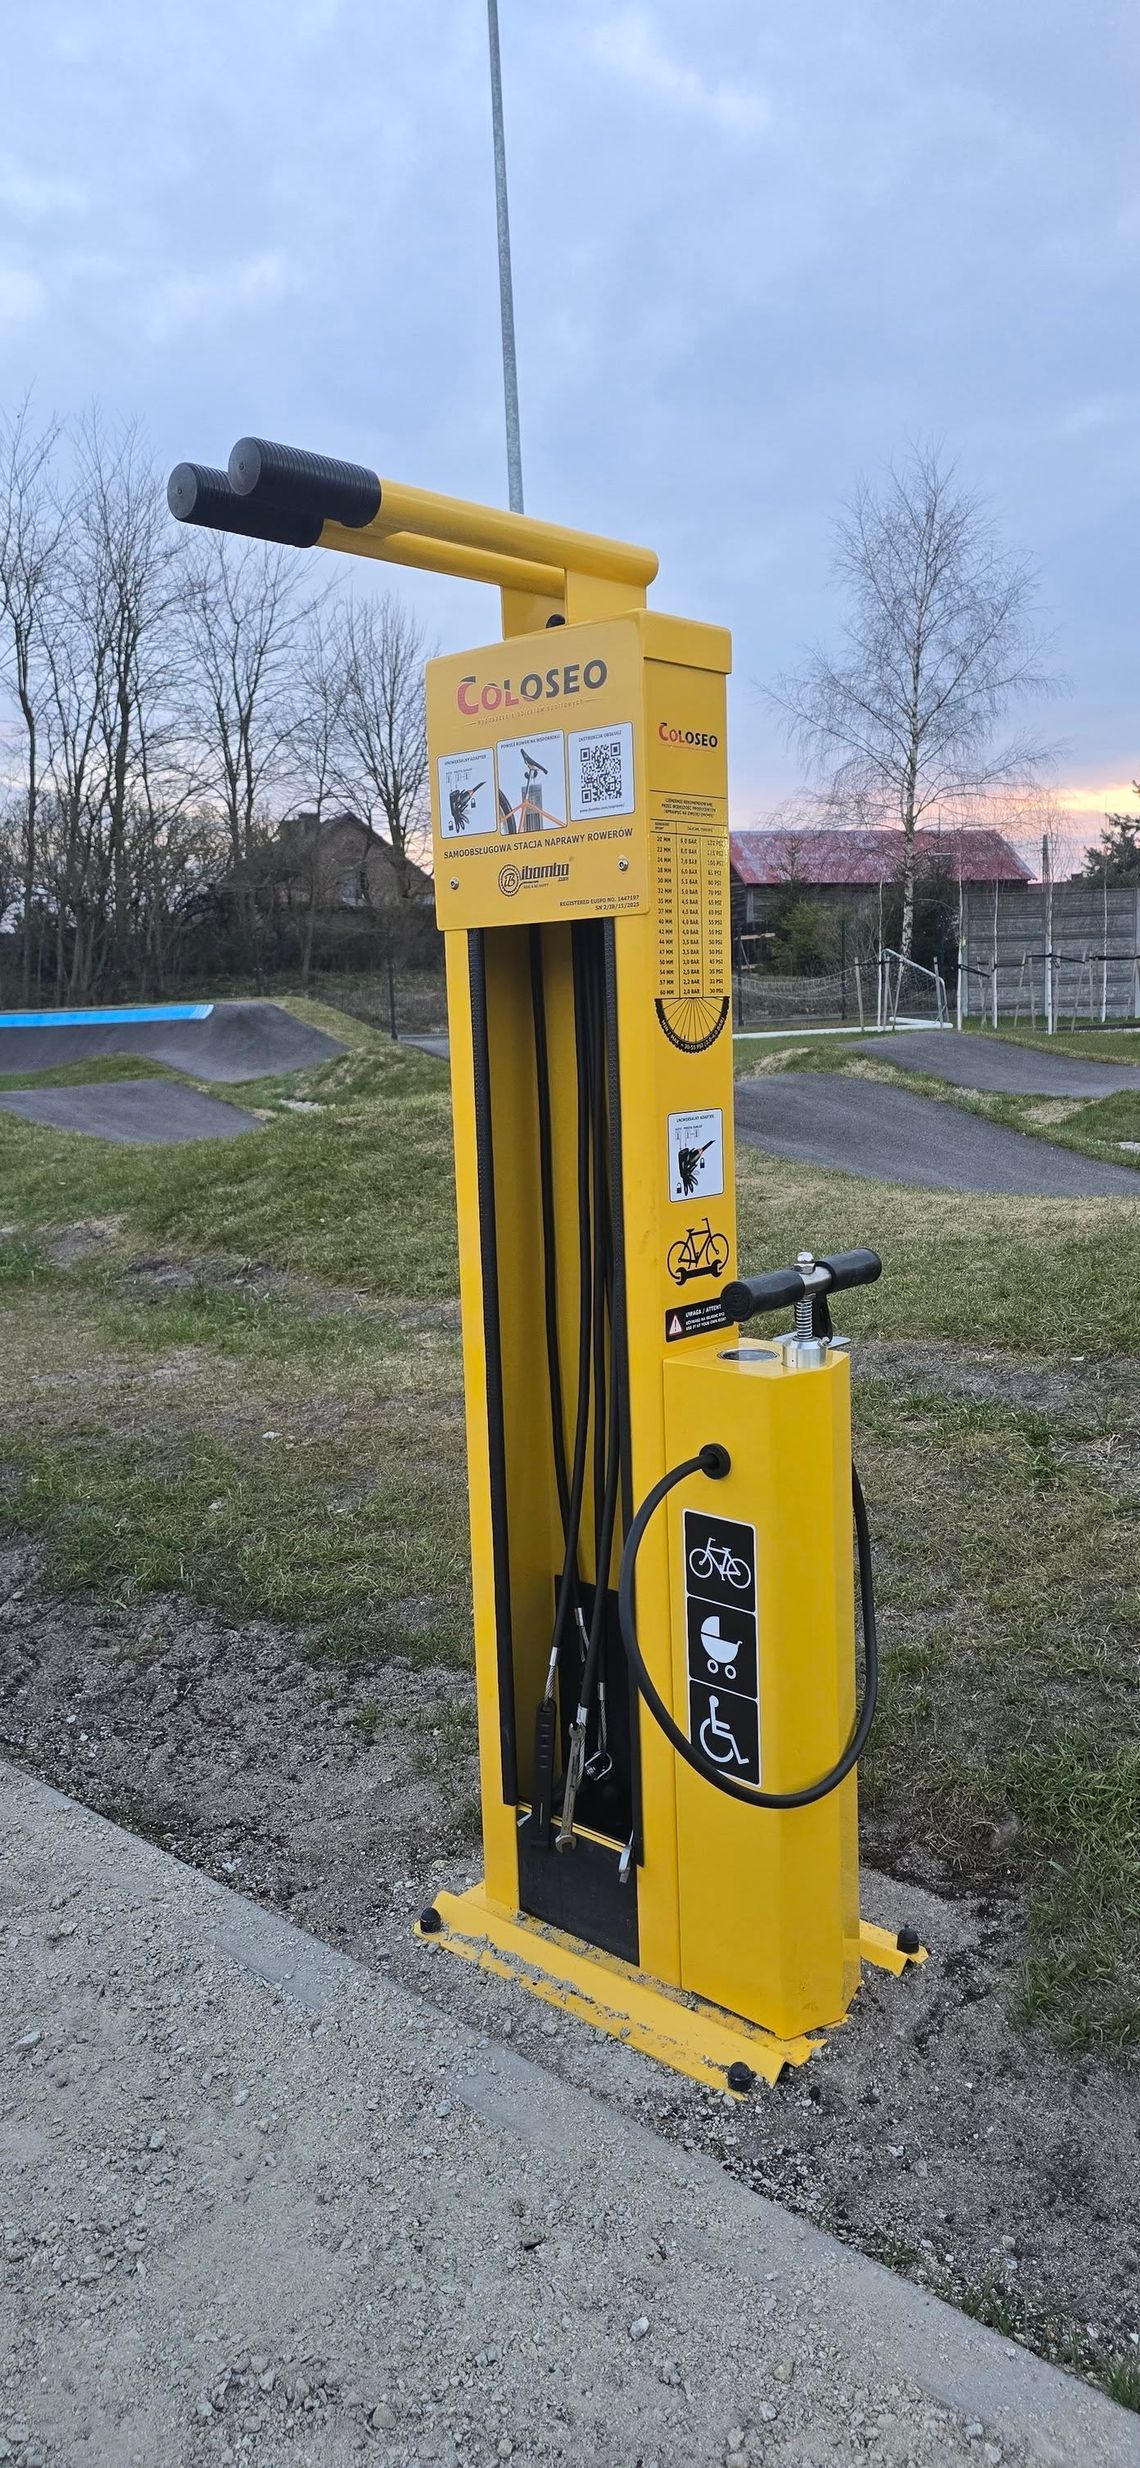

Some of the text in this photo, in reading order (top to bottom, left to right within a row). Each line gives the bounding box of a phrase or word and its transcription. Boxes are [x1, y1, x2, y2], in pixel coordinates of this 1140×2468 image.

[457, 659, 607, 715] COLOSEO
[658, 722, 718, 748] COLOSEO
[444, 826, 633, 859] SAMOOBSŁUGOWA STACJA NAPRAWY ROWERÓW
[521, 862, 569, 880] ibombo
[560, 899, 590, 907] REGISTERED
[685, 1309, 702, 1318] UWAGA
[705, 1304, 722, 1313] ATTENT
